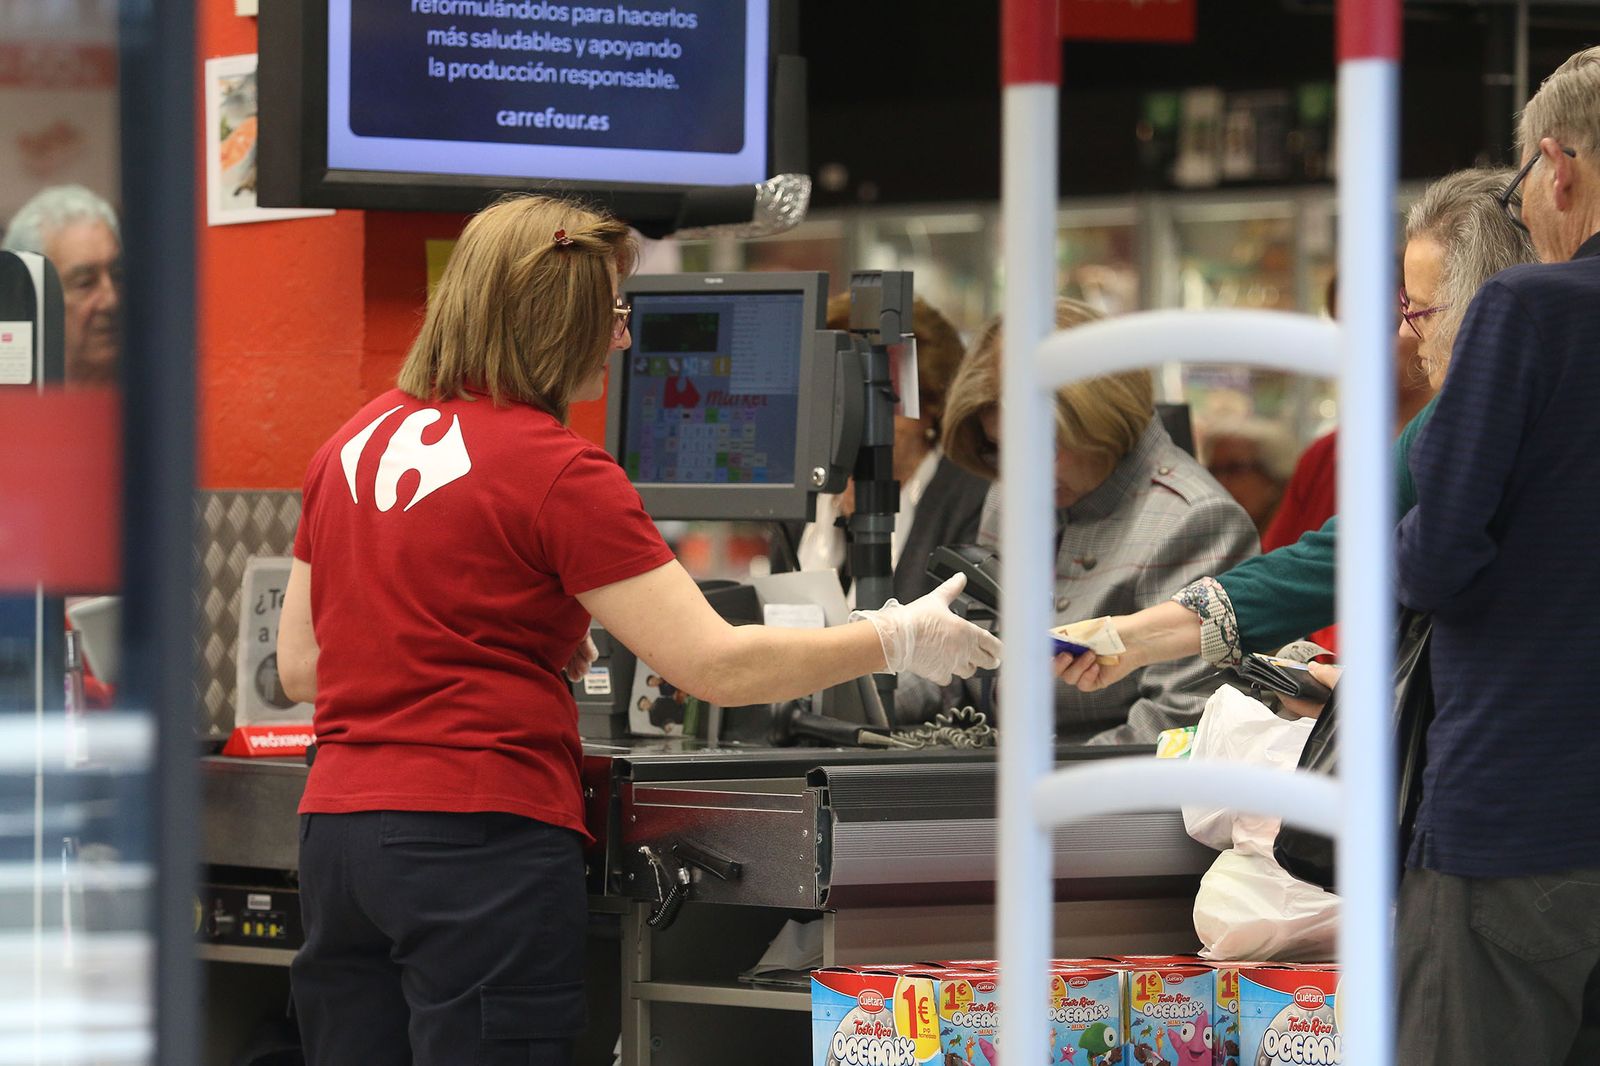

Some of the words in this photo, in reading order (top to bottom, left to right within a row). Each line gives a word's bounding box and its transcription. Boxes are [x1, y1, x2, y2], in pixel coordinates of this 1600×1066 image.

[411, 0, 570, 21] reformulándolos
[571, 7, 615, 27] para
[617, 4, 698, 29] hacerlos
[427, 25, 469, 47] más
[470, 28, 572, 53] saludables
[573, 38, 587, 59] y
[588, 38, 682, 60] apoyando
[428, 56, 445, 77] la
[448, 60, 558, 83] producción
[560, 68, 679, 90] responsable.
[496, 107, 610, 131] carrefour.es
[859, 995, 884, 1007] Cuétara
[1079, 997, 1095, 1008] Rica
[1175, 993, 1191, 1004] Rica
[1295, 991, 1324, 1003] Cuétara
[1048, 1005, 1109, 1023] OCEANIX
[1143, 1000, 1204, 1019] OCEANIX
[853, 1020, 873, 1036] Tosta
[873, 1021, 892, 1039] Rica
[1287, 1016, 1311, 1033] Tosta
[1311, 1016, 1333, 1036] Rica
[832, 1031, 915, 1066] OCEANIX
[1263, 1028, 1342, 1066] OCEANI
